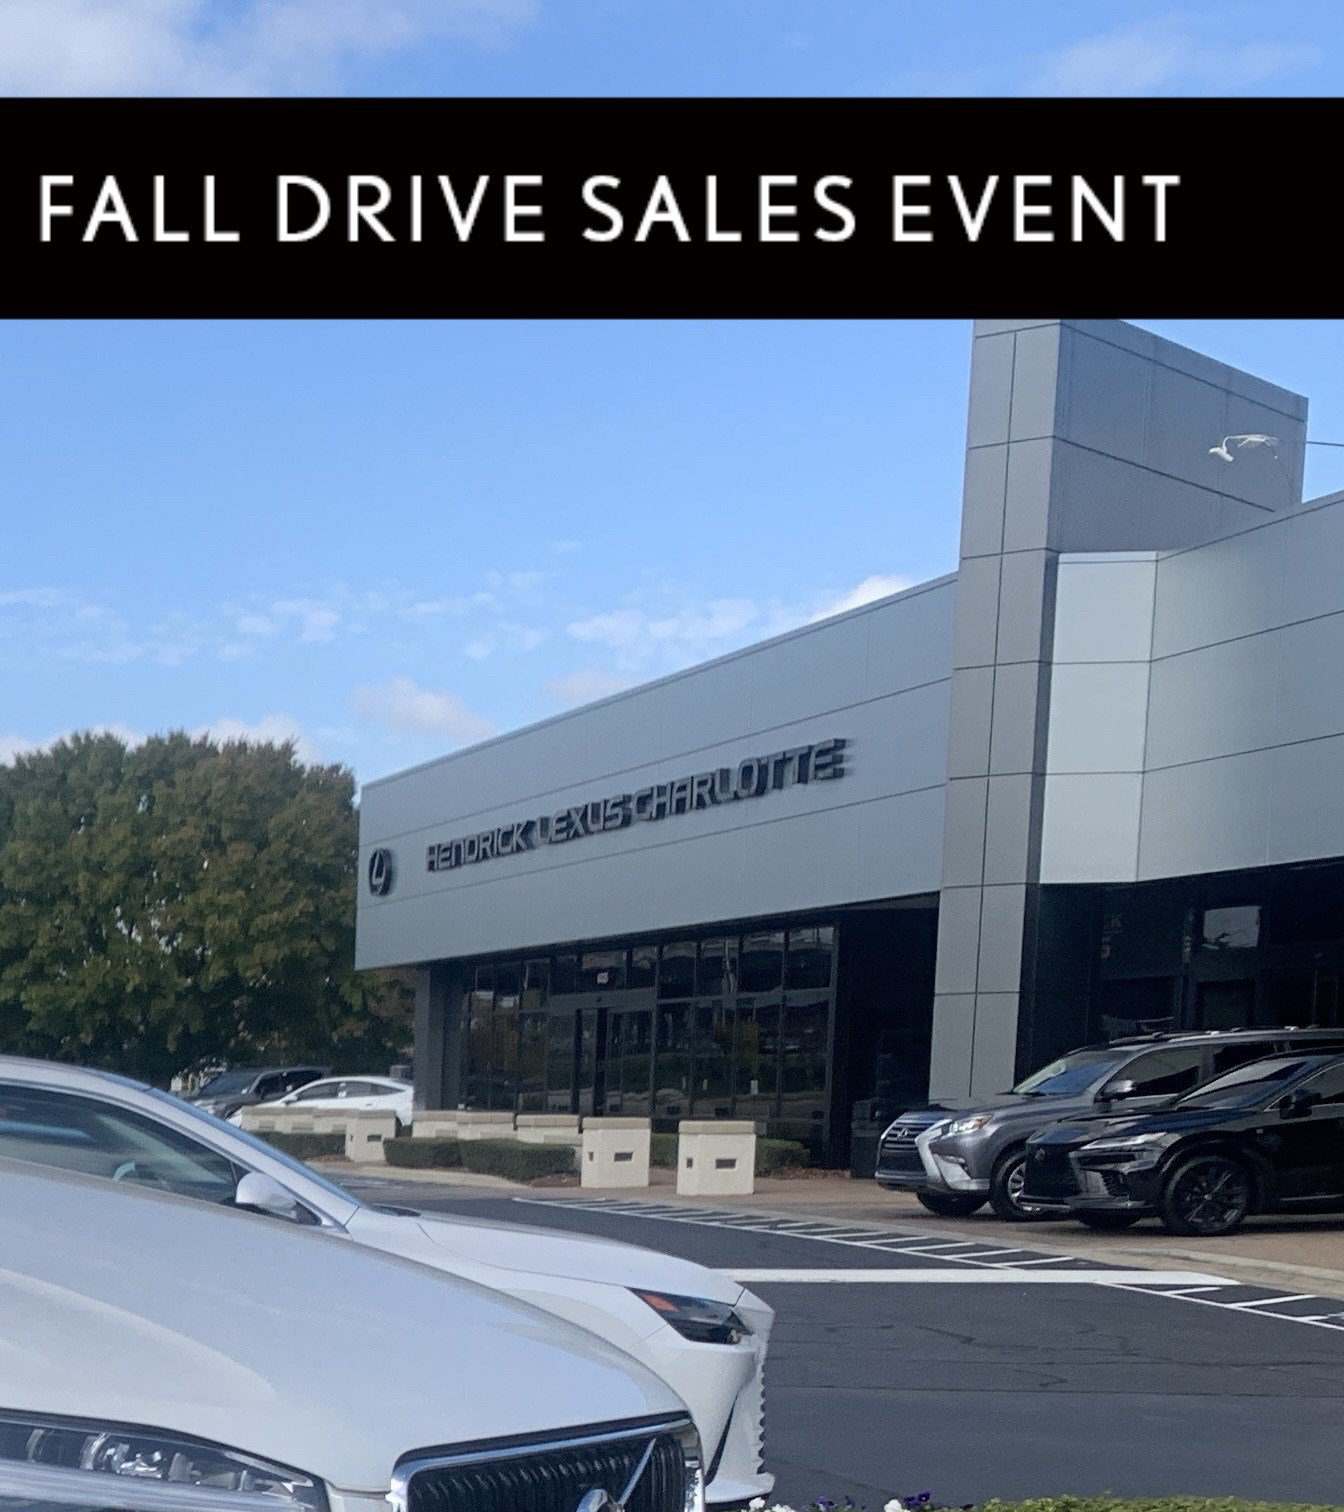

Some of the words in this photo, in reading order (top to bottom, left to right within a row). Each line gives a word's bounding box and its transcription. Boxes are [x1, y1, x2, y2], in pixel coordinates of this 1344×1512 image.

[426, 819, 537, 872] HENDRICK
[536, 793, 632, 845] LEXUS
[631, 738, 851, 822] CHARLOTTE
